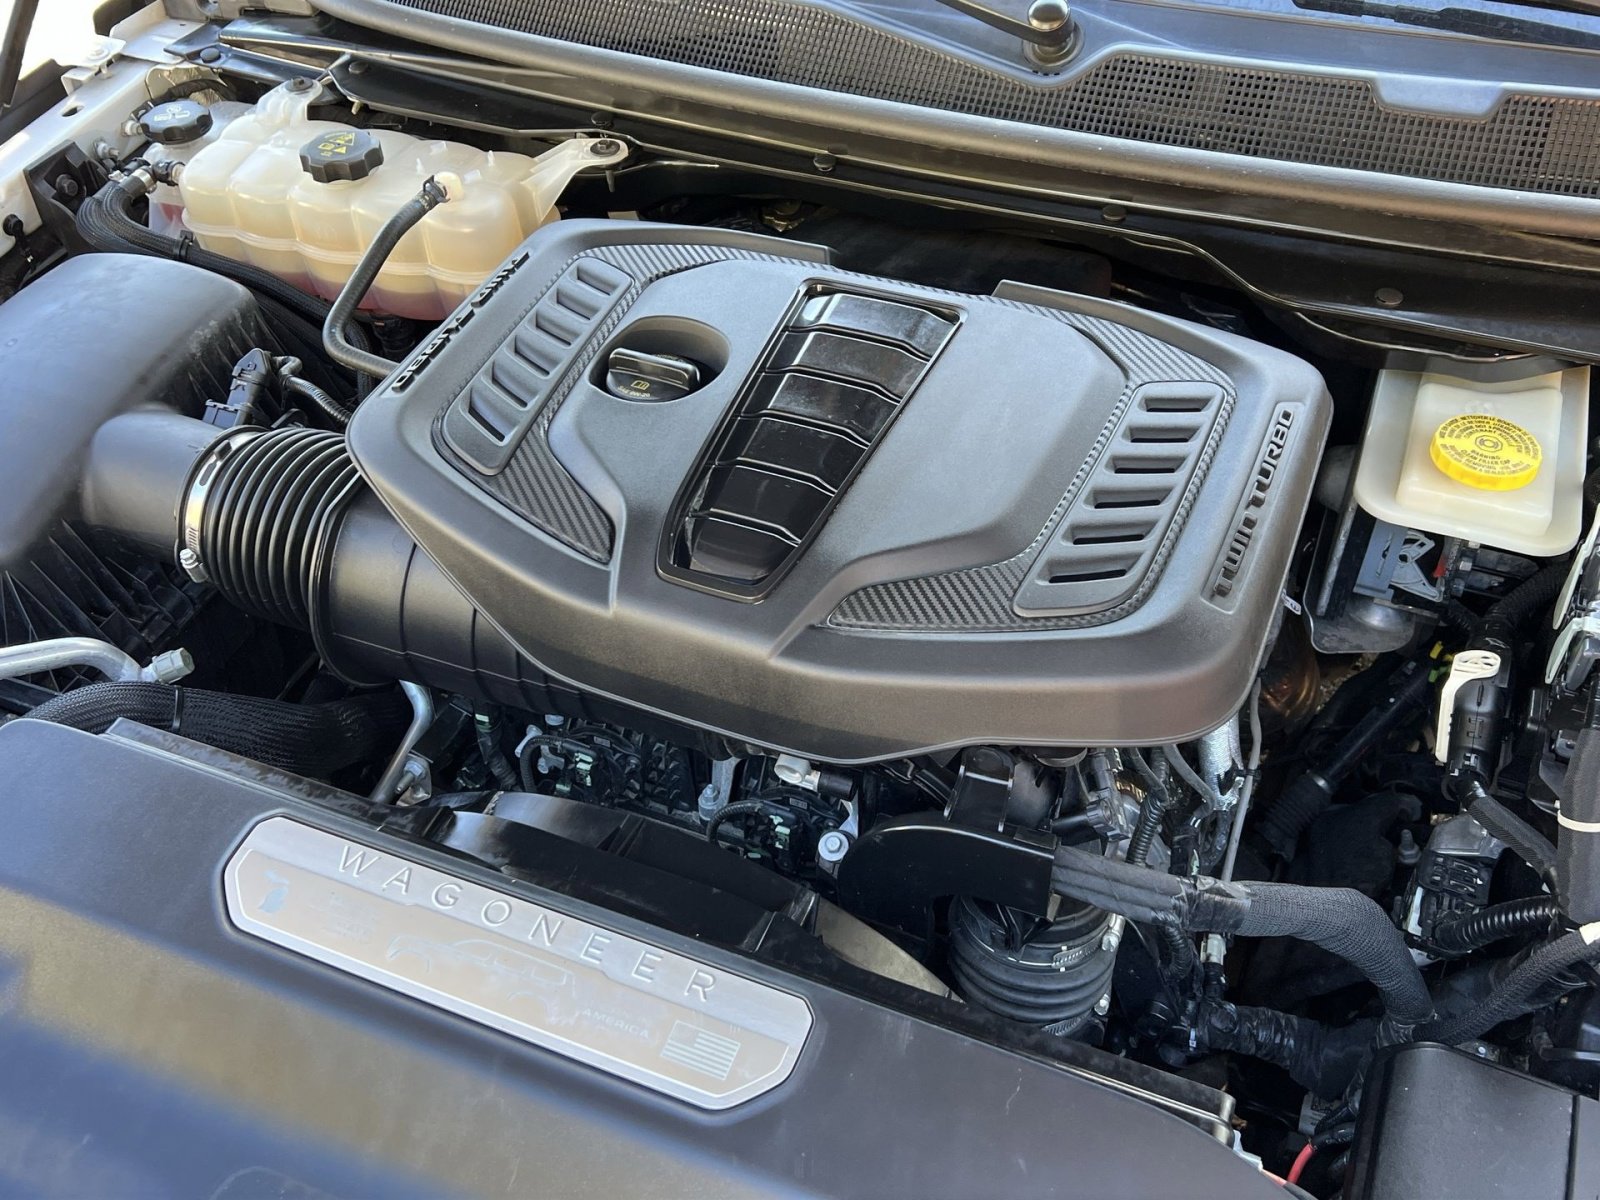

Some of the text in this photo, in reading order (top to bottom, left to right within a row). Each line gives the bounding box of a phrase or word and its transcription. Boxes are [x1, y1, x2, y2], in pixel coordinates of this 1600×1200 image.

[391, 309, 475, 393] TURBO
[1213, 409, 1294, 598] TWIN TURBO
[337, 845, 718, 1001] WAGONEER
[581, 1007, 650, 1039] AMERICA
